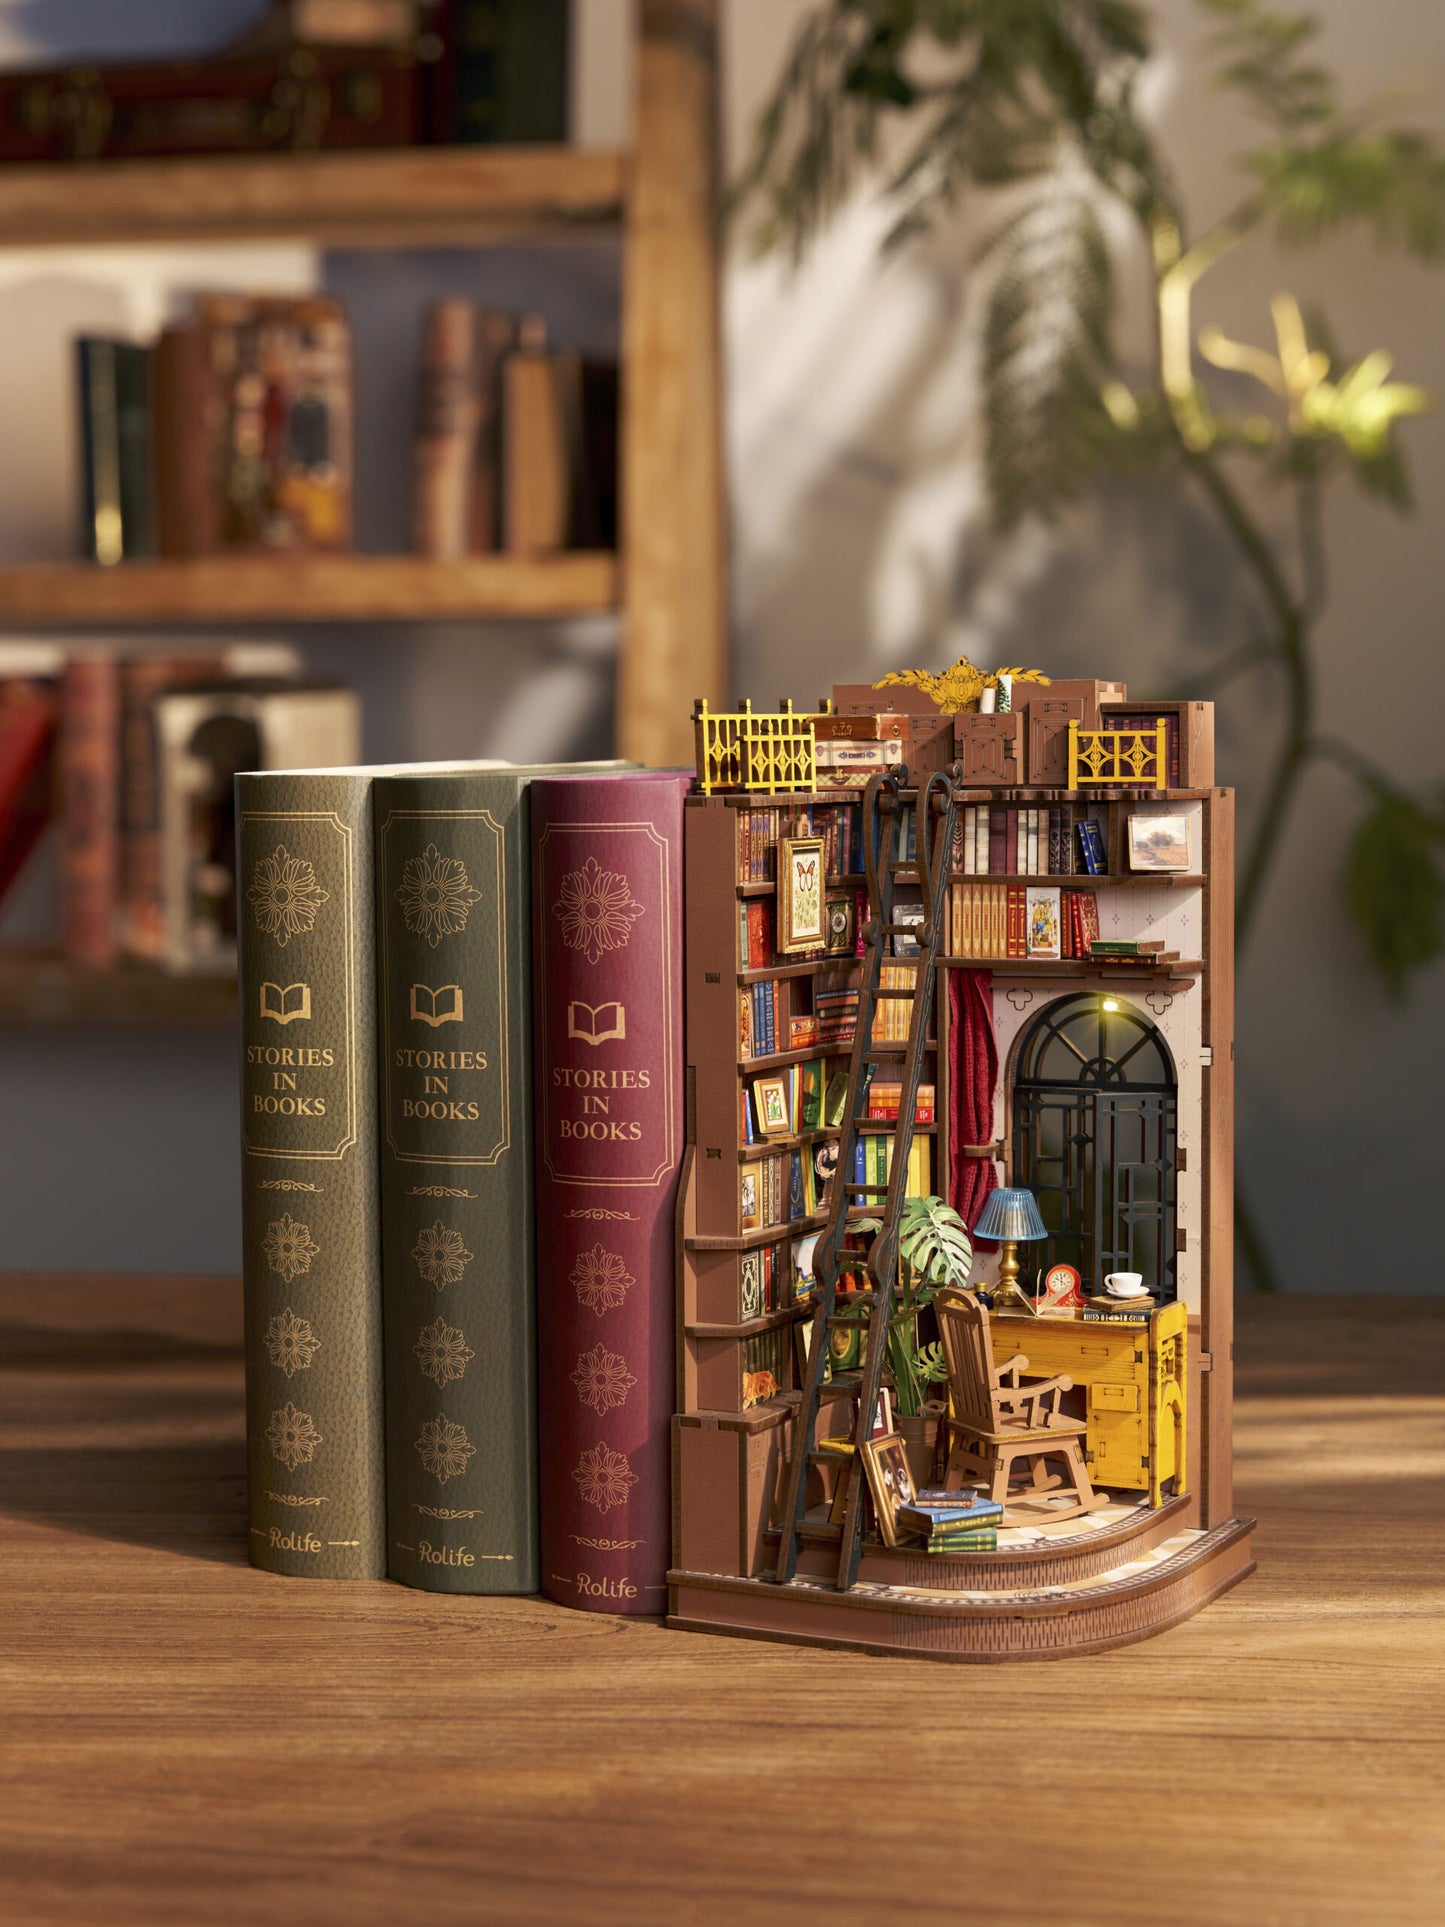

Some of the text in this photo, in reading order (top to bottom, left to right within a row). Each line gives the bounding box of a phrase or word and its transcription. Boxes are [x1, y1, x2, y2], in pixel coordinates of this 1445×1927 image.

[247, 1045, 334, 1067] STORIES
[396, 1048, 488, 1070] STORIES
[272, 1072, 297, 1091] IN
[423, 1075, 449, 1095] IN
[553, 1067, 651, 1089] STORIES
[253, 1094, 326, 1116] BOOKS
[403, 1098, 480, 1121] BOOKS
[582, 1095, 610, 1115] IN
[560, 1119, 642, 1141] BOOKS
[269, 1526, 322, 1553] Rolife
[418, 1541, 475, 1567] Rolife
[576, 1572, 638, 1599] Rolife
